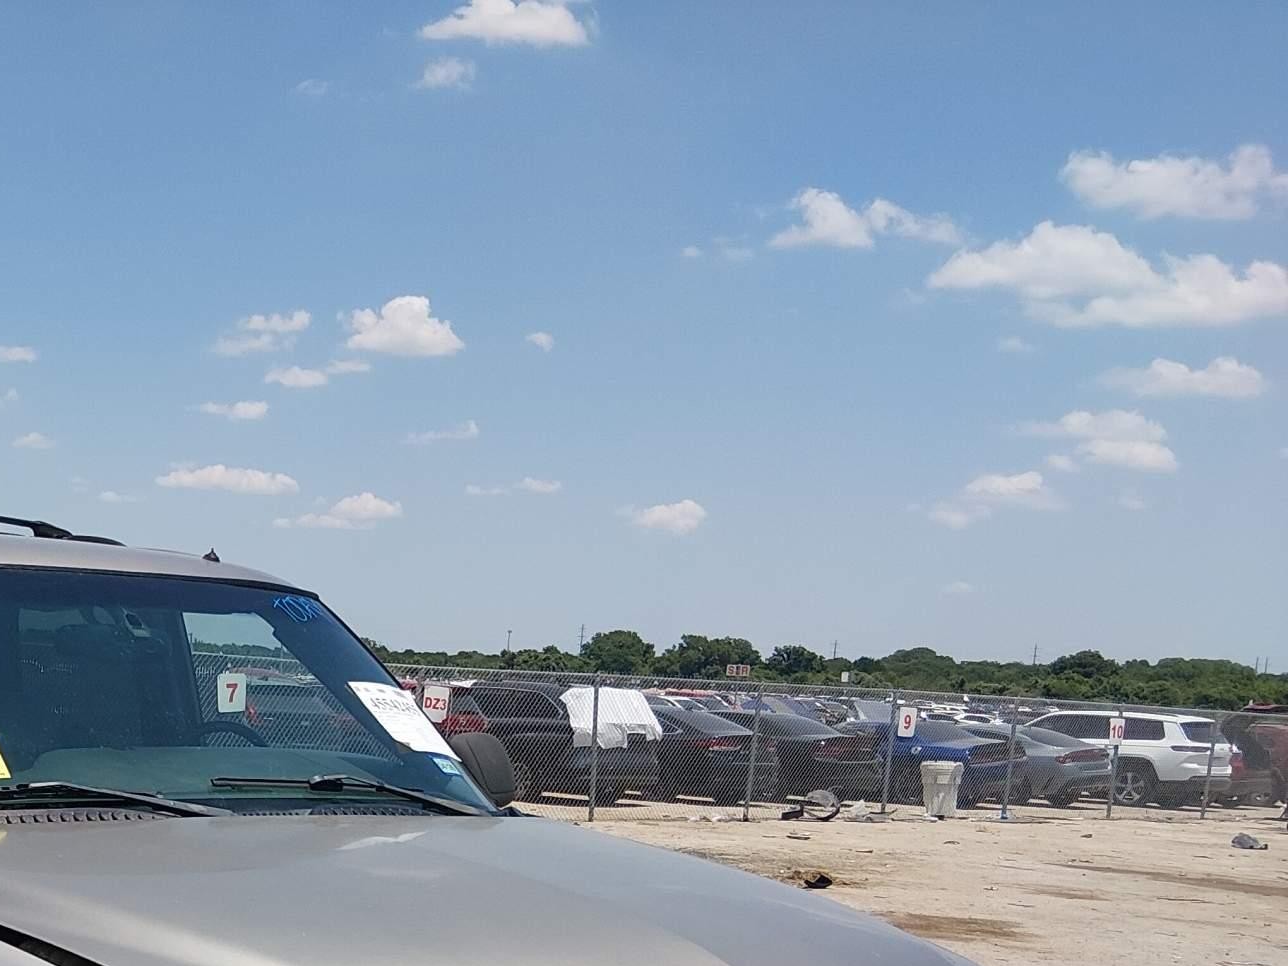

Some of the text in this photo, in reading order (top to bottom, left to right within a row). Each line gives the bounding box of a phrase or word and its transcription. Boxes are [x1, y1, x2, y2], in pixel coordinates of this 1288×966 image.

[226, 683, 238, 703] 7
[424, 697, 447, 711] DZ3
[903, 714, 912, 730] 9
[1111, 724, 1123, 739] 10
